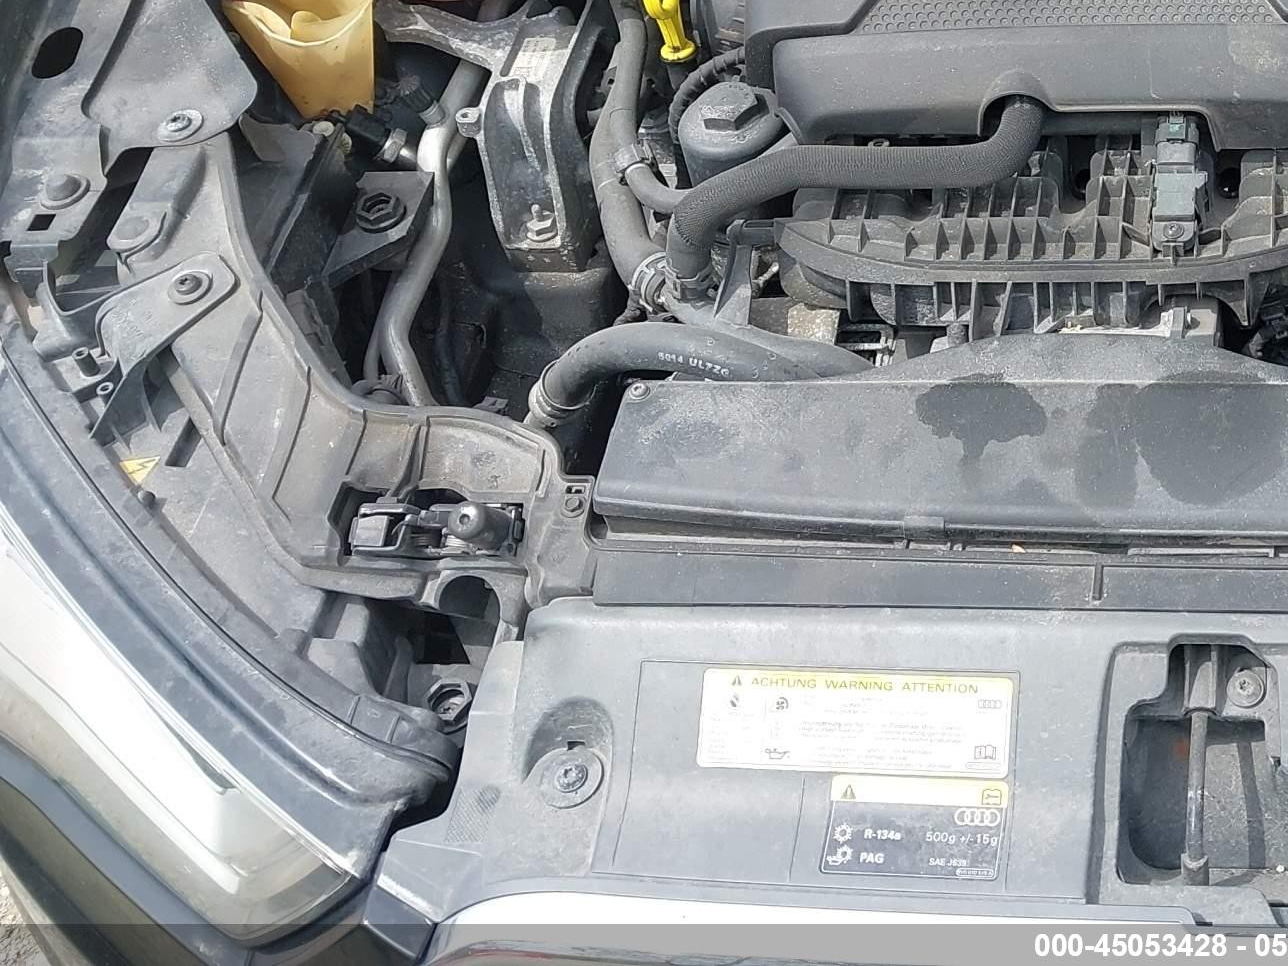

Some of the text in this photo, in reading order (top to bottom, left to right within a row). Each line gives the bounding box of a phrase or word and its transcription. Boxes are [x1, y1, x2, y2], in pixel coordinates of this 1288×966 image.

[751, 676, 979, 694] ACHTUNG WARNING ATTENTION
[864, 829, 902, 841] R-134a
[925, 832, 956, 843] 500g
[859, 853, 885, 863] PAG
[929, 858, 945, 866] SAE
